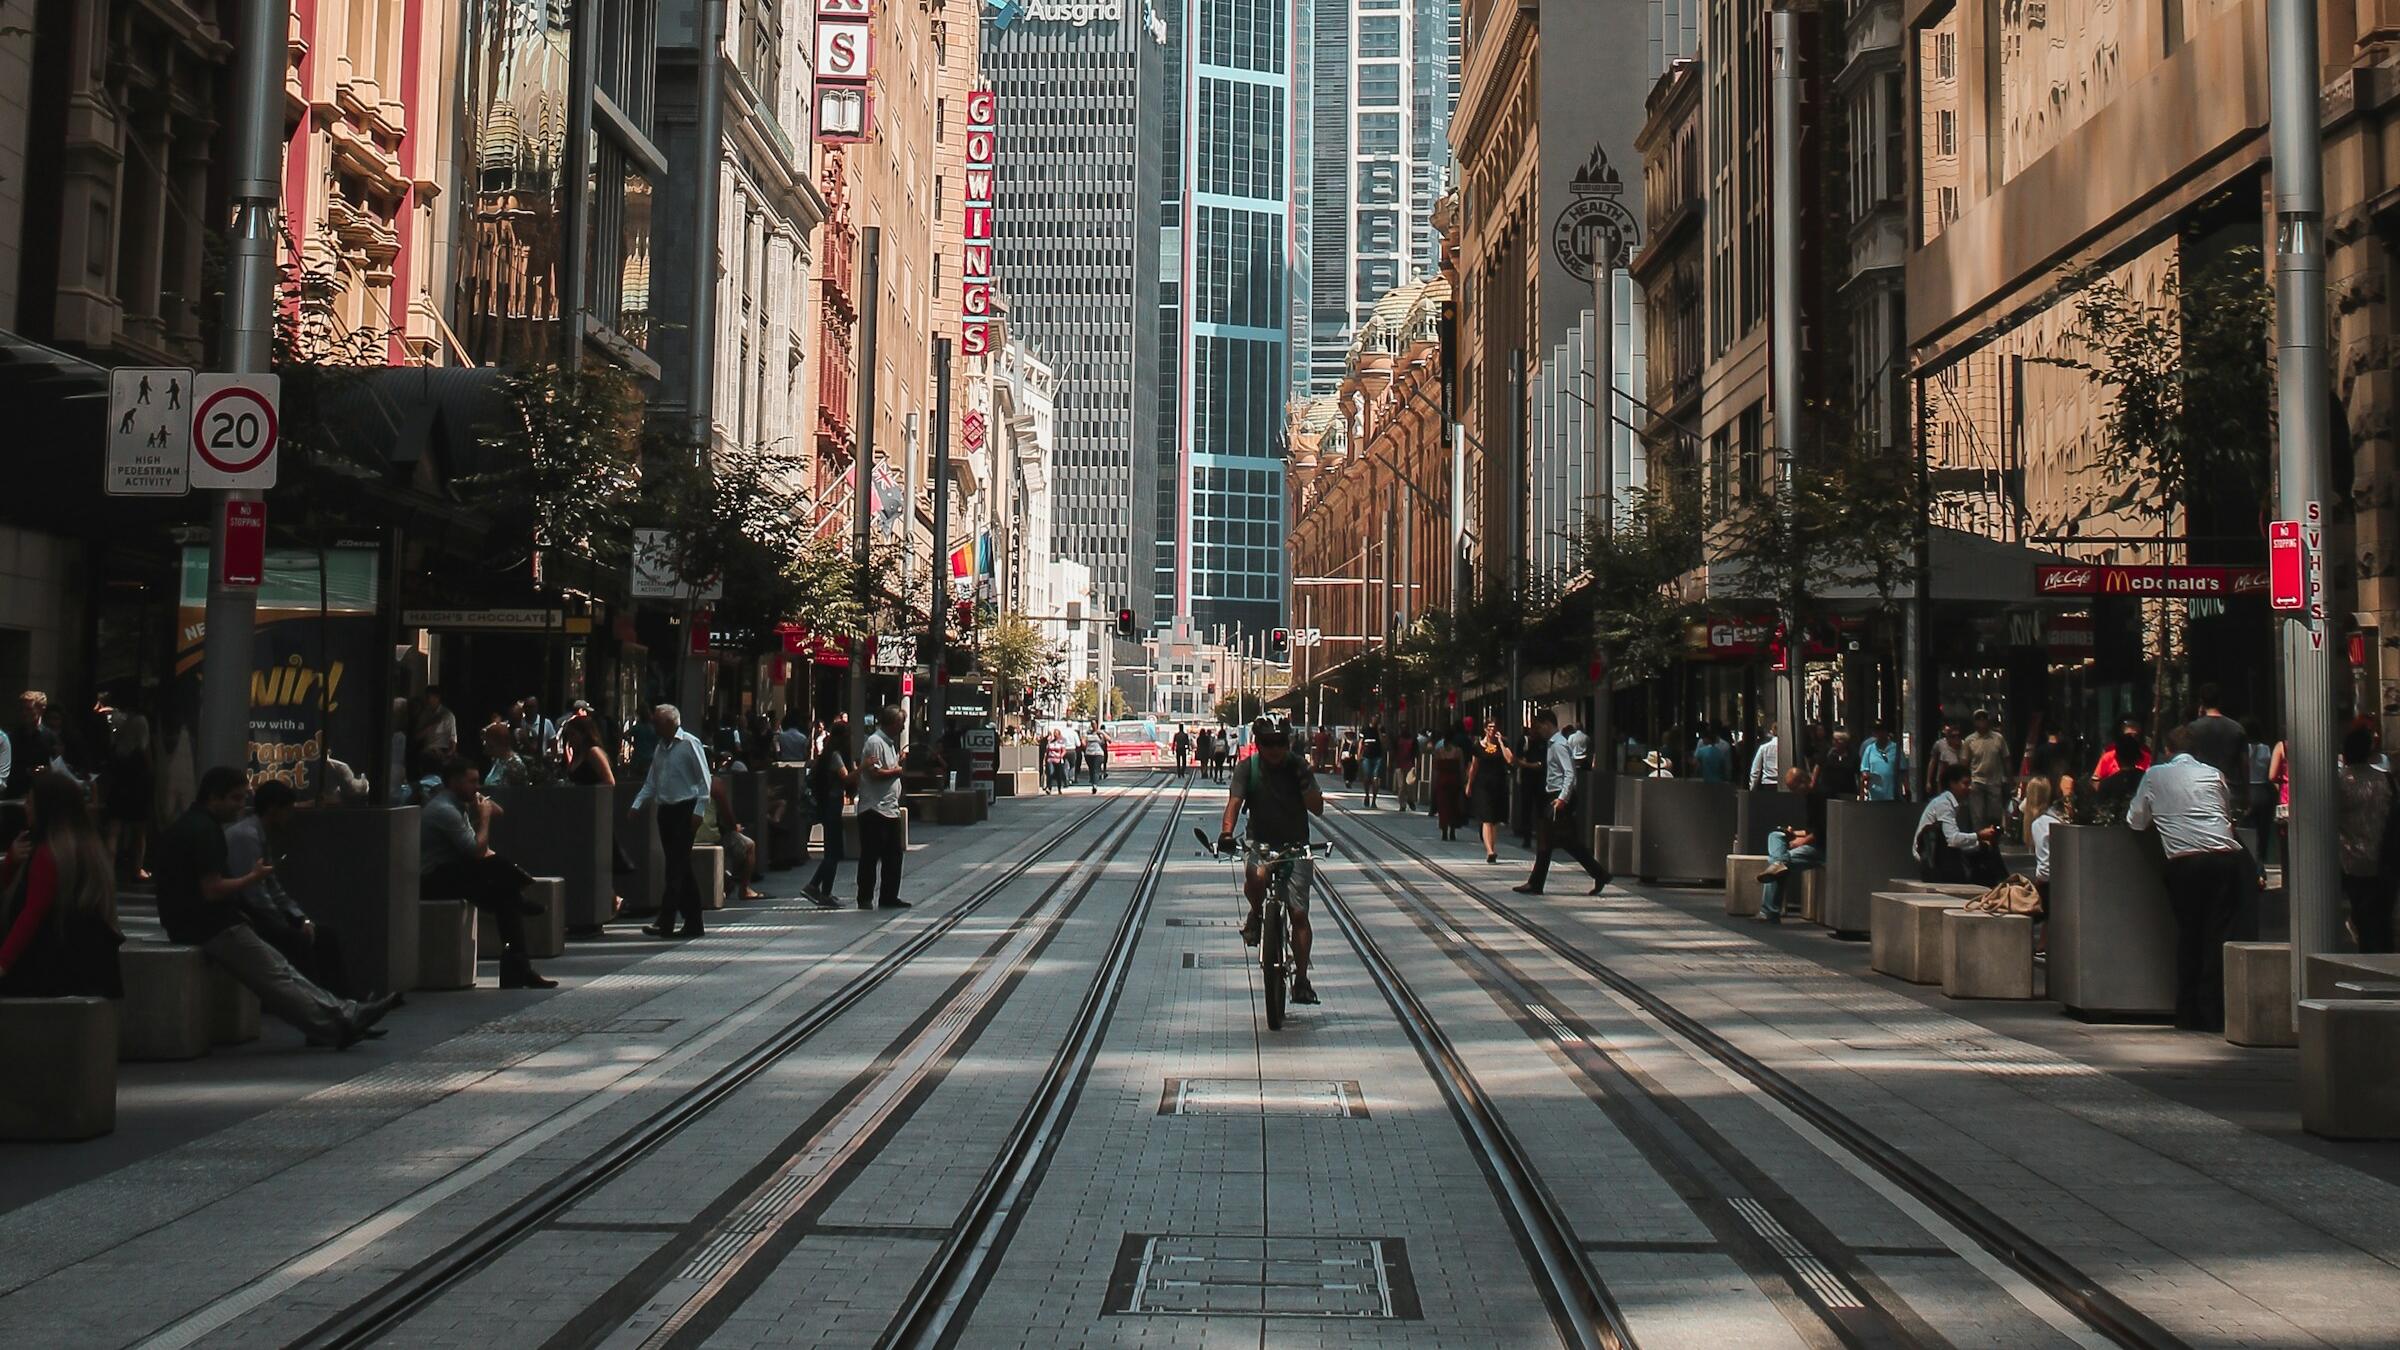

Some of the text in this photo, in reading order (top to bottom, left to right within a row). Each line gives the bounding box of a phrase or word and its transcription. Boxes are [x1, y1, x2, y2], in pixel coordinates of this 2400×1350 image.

[1025, 0, 1120, 27] Ausgrid
[1568, 201, 1625, 221] HEALTH
[964, 95, 993, 353] GOWINGS
[1557, 239, 1586, 275] CARE
[211, 412, 260, 449] 20
[135, 455, 161, 465] HIGH
[117, 467, 180, 476] PEDESTRIAN
[124, 477, 172, 487] ACTIVITY
[240, 506, 252, 516] NO
[230, 517, 261, 528] STOPPING
[2280, 526, 2289, 537] NO
[2272, 538, 2298, 549] STOPPING
[1011, 515, 1020, 611] GALERIES
[2105, 570, 2220, 592] McDonald's
[410, 612, 556, 624] HAIGH'S CHOCOLATES
[185, 622, 206, 641] NE
[249, 720, 267, 729] ow
[269, 719, 296, 730] with
